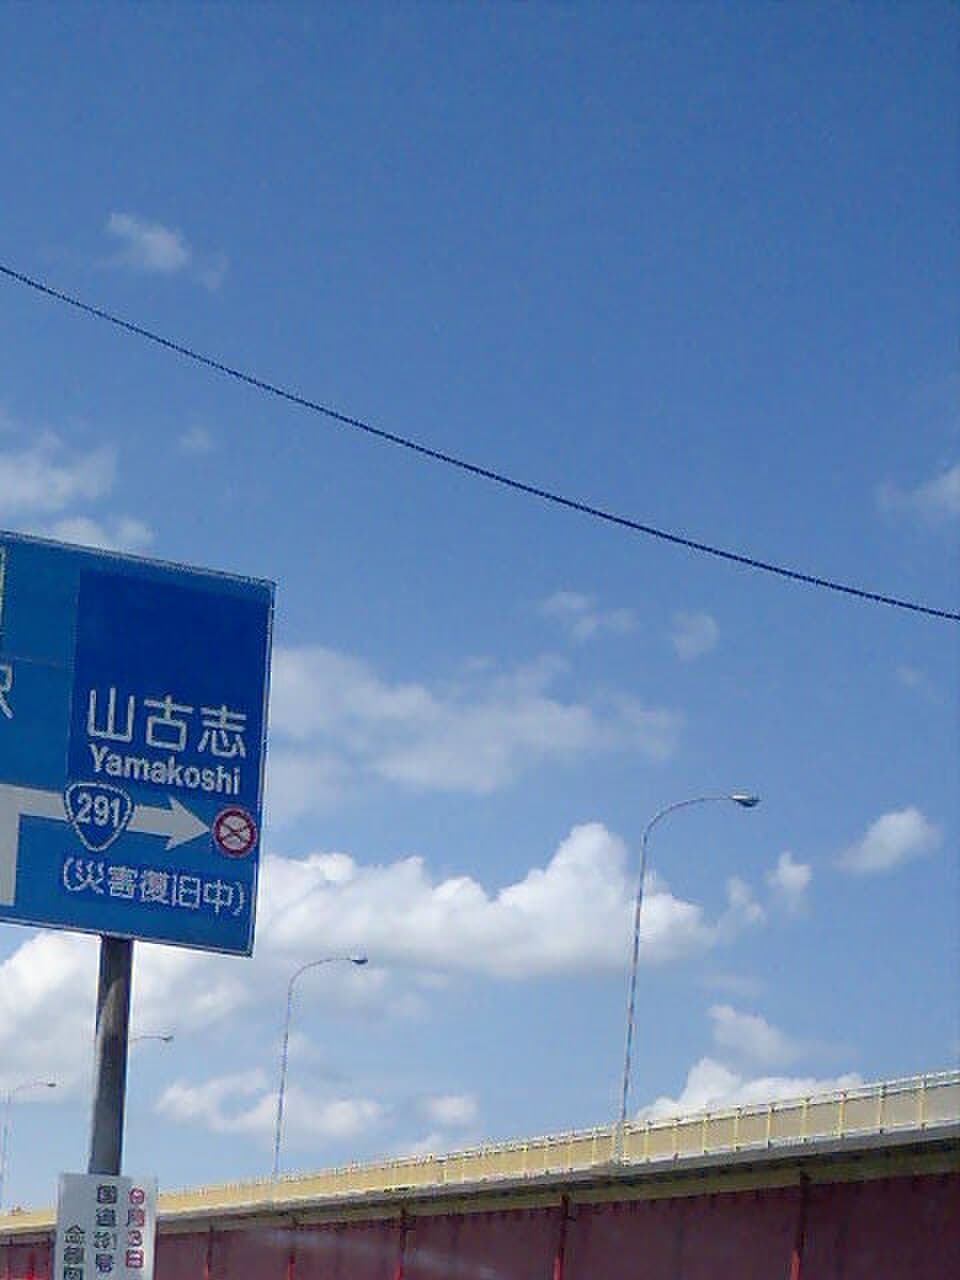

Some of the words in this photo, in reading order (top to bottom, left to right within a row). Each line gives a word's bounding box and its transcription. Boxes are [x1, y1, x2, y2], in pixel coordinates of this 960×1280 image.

[87, 688, 246, 759] 山古志
[88, 743, 241, 796] Yamakoshi
[77, 792, 121, 828] 291
